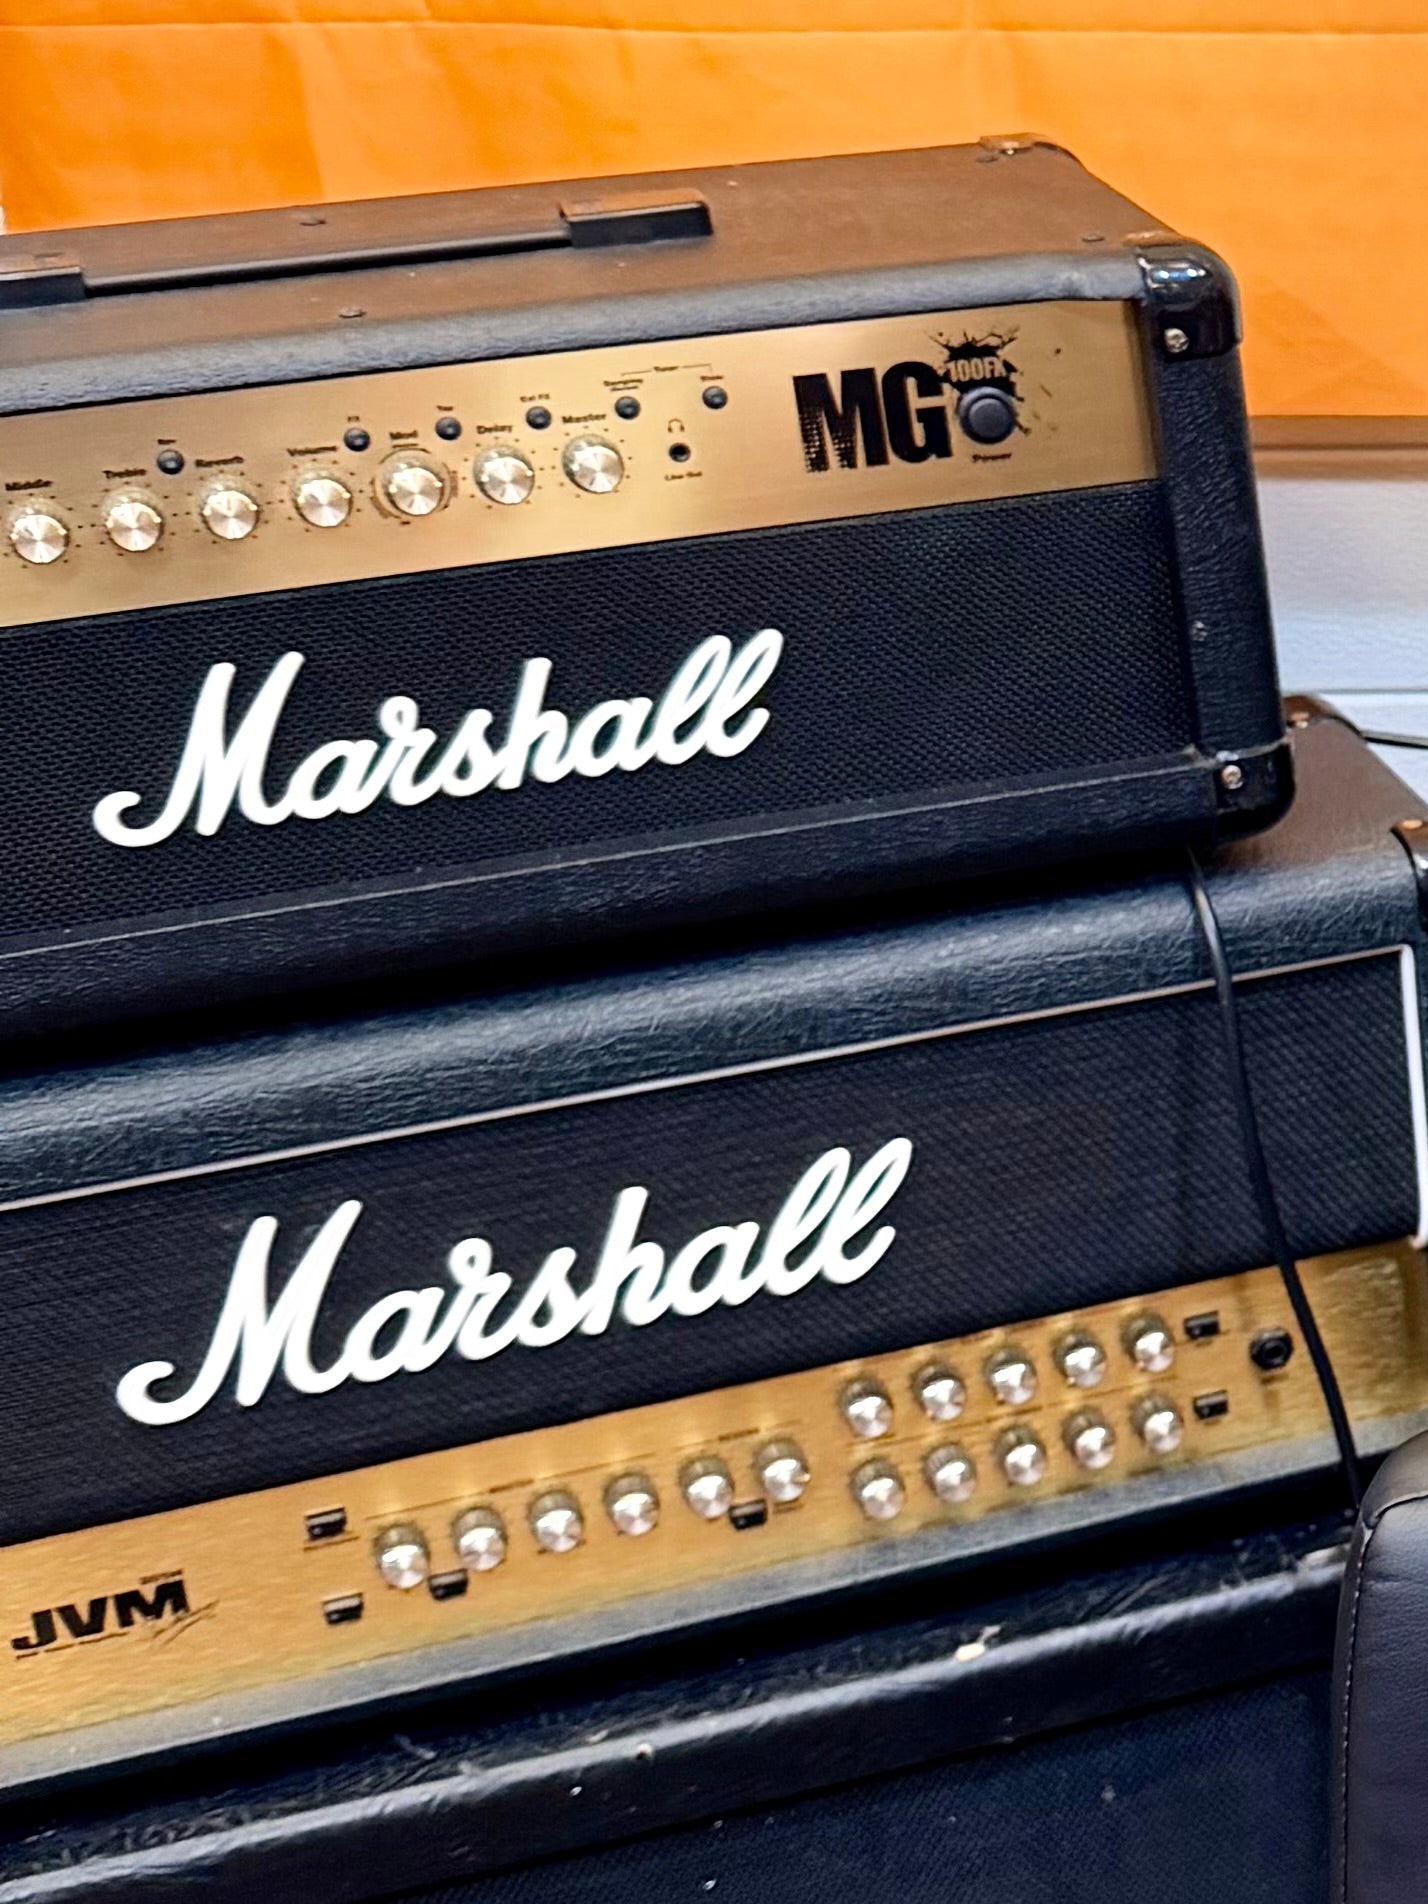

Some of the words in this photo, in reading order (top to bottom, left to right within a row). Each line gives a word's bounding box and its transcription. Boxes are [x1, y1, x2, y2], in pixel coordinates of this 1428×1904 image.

[561, 412, 608, 425] Master
[793, 361, 953, 473] MG
[476, 423, 513, 436] Delay
[287, 444, 338, 457] Volume
[195, 455, 244, 468] Reverb
[971, 452, 1012, 464] Power
[103, 468, 147, 480] Treble
[93, 627, 785, 848] Marshall
[116, 1136, 914, 1427] Marshall
[11, 1578, 190, 1651] JVM
